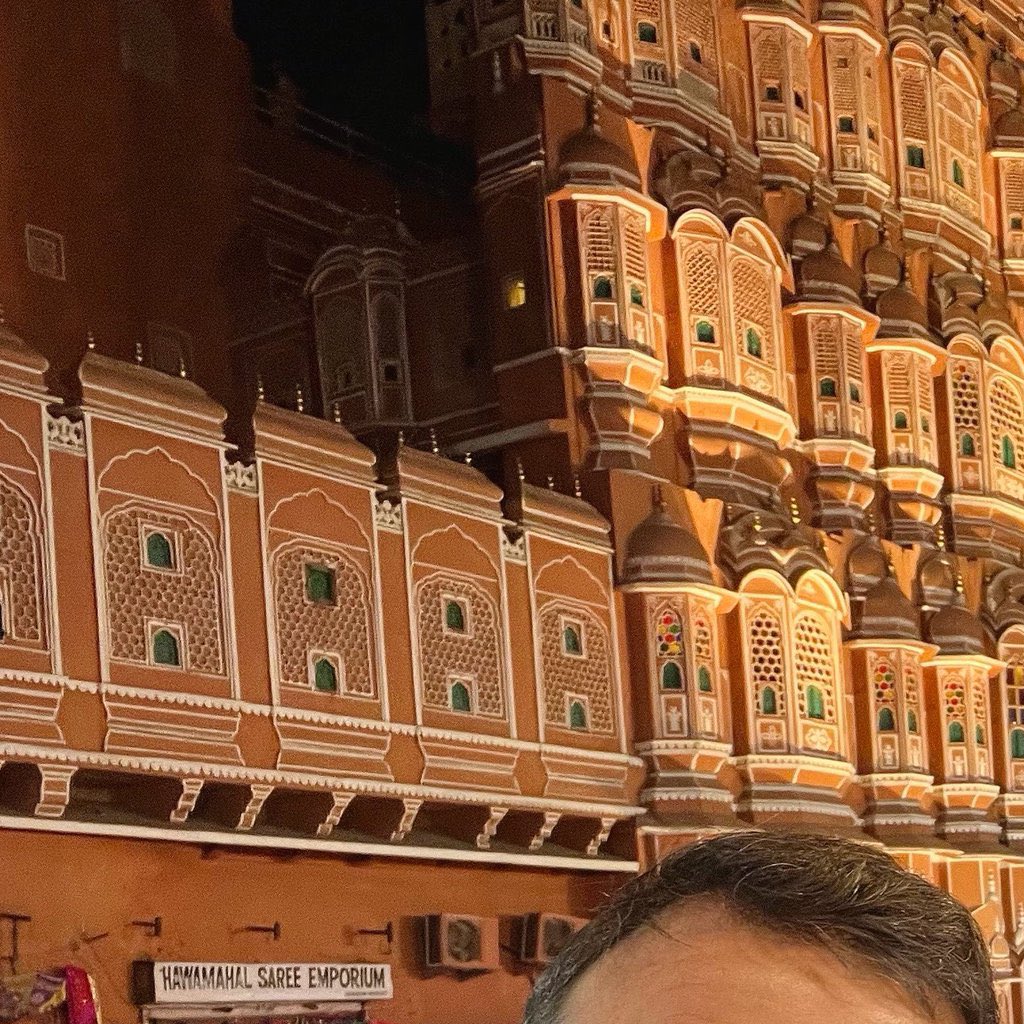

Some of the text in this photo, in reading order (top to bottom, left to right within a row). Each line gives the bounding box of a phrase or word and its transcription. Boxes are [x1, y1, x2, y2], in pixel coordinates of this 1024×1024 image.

[162, 965, 386, 991] HAWAMAHAL SAREE EMPORIUM
